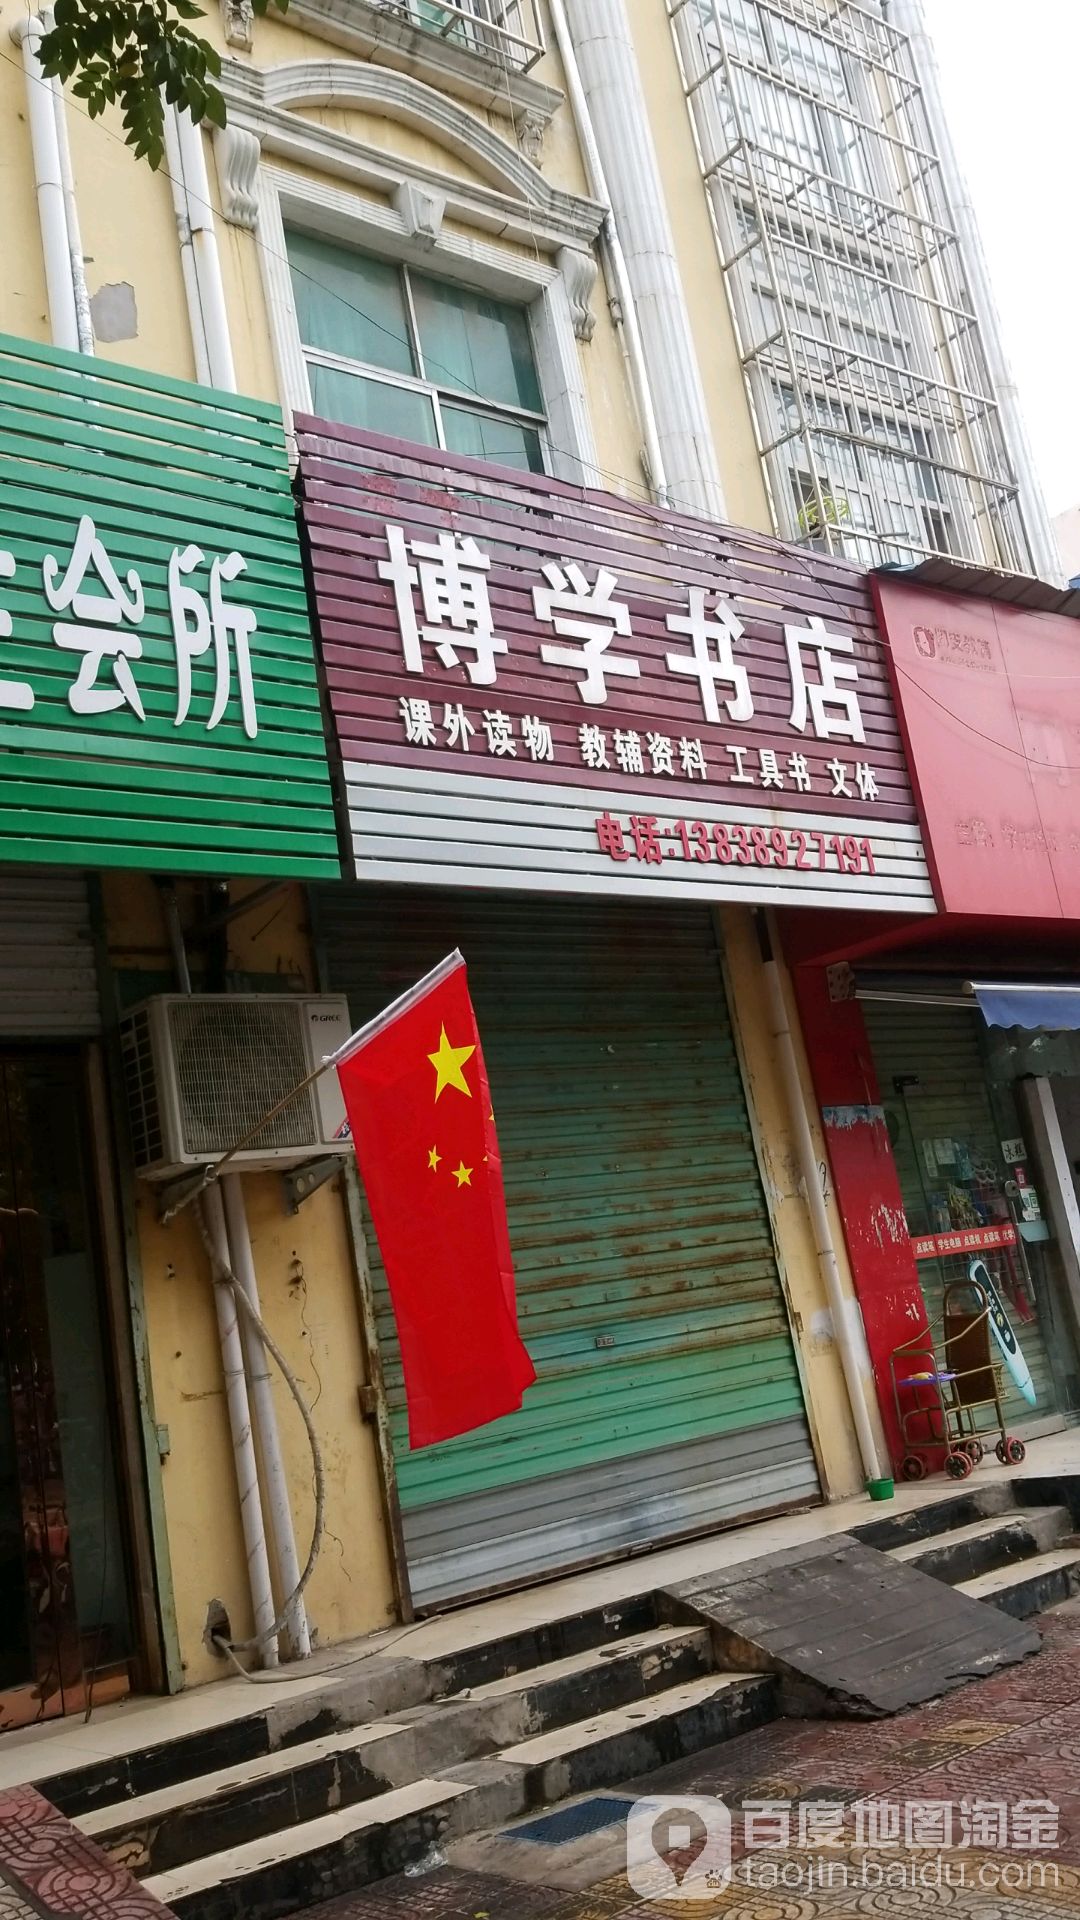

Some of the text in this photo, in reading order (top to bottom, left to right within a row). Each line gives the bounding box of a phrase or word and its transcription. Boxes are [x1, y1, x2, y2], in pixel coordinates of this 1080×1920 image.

[0, 514, 257, 739] 会所
[377, 524, 867, 744] 博学书店
[398, 696, 880, 802] 课外读物 教辅资料 工具书 文体
[595, 811, 877, 876] 电话:13838927191
